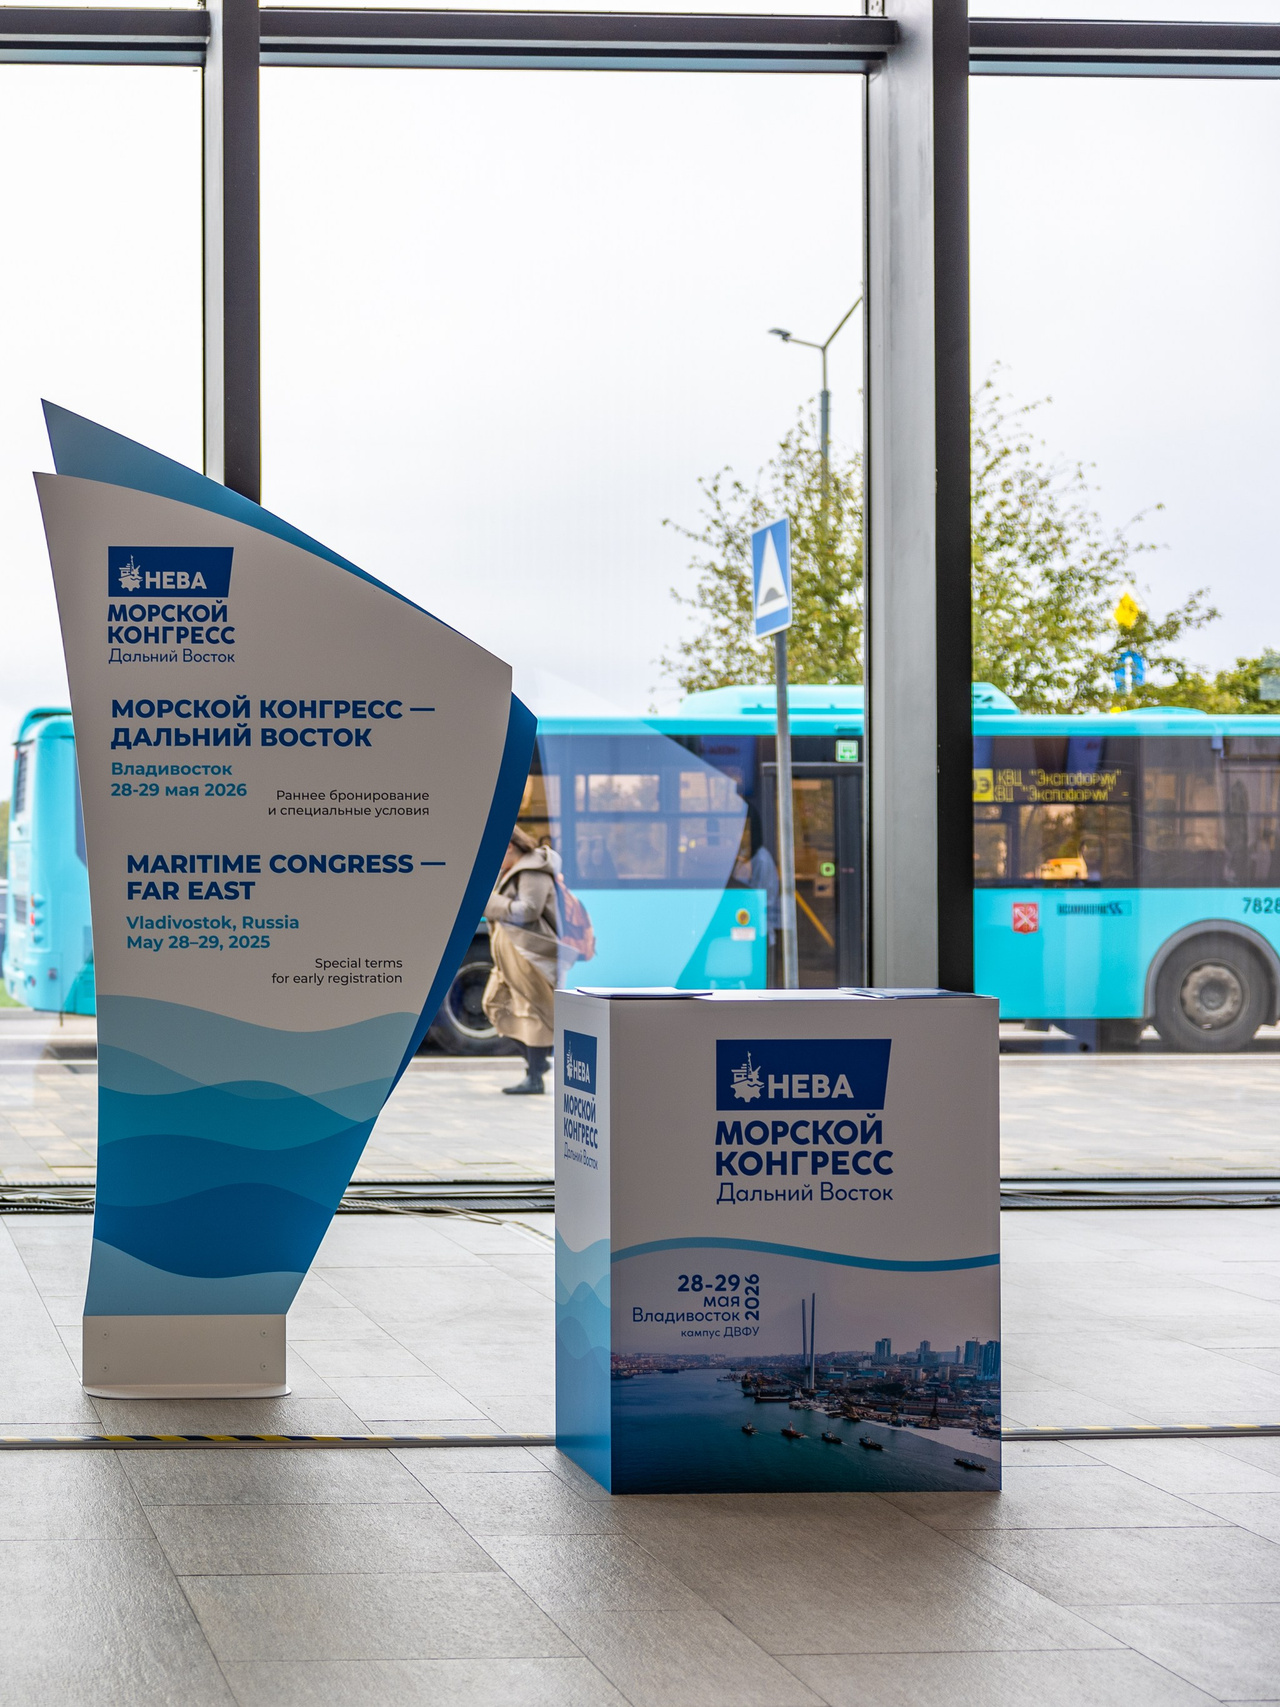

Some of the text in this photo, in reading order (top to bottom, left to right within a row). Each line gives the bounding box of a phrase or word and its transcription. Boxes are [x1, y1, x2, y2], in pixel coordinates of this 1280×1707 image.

[146, 571, 207, 589] НЕВА
[108, 600, 227, 622] МОРСКОЙ
[108, 626, 235, 644] КОНГРЕСС
[109, 648, 235, 664] Дальний Восток
[112, 695, 250, 718] МОРСКОЙ
[260, 700, 403, 719] КОНГРЕСС
[111, 723, 372, 749] ДАЛЬНИЙ ВОСТОК
[112, 762, 232, 777] Владивосток
[997, 770, 1022, 786] КВЦ
[111, 783, 247, 796] 28-29 мая 2026
[277, 790, 429, 802] Раннее бронирование
[280, 808, 371, 816] специальные
[375, 808, 429, 818] условия
[128, 855, 261, 873] MARITIME
[269, 855, 413, 873] CONGRESS
[128, 881, 255, 900] FAR EAST
[126, 915, 299, 931] Vladivostok, Russia
[128, 936, 163, 952] May
[229, 935, 270, 948] 2025
[315, 958, 402, 970] Special terms
[272, 973, 402, 986] for early registration
[572, 1059, 590, 1084] НЕВА
[768, 1074, 854, 1098] НЕВА
[564, 1093, 596, 1123] МОРСКОЙ
[563, 1117, 599, 1150] КОНГРЕСС
[715, 1113, 883, 1146] МОРСКОЙ
[716, 1150, 893, 1176] КОНГРЕСС
[717, 1182, 893, 1205] Дальний Восток
[678, 1274, 740, 1292] 28-29
[704, 1296, 739, 1307] мая
[745, 1274, 759, 1321] 2026
[632, 1306, 740, 1324] Владивосток
[681, 1327, 759, 1339] кампус ДВФУ
